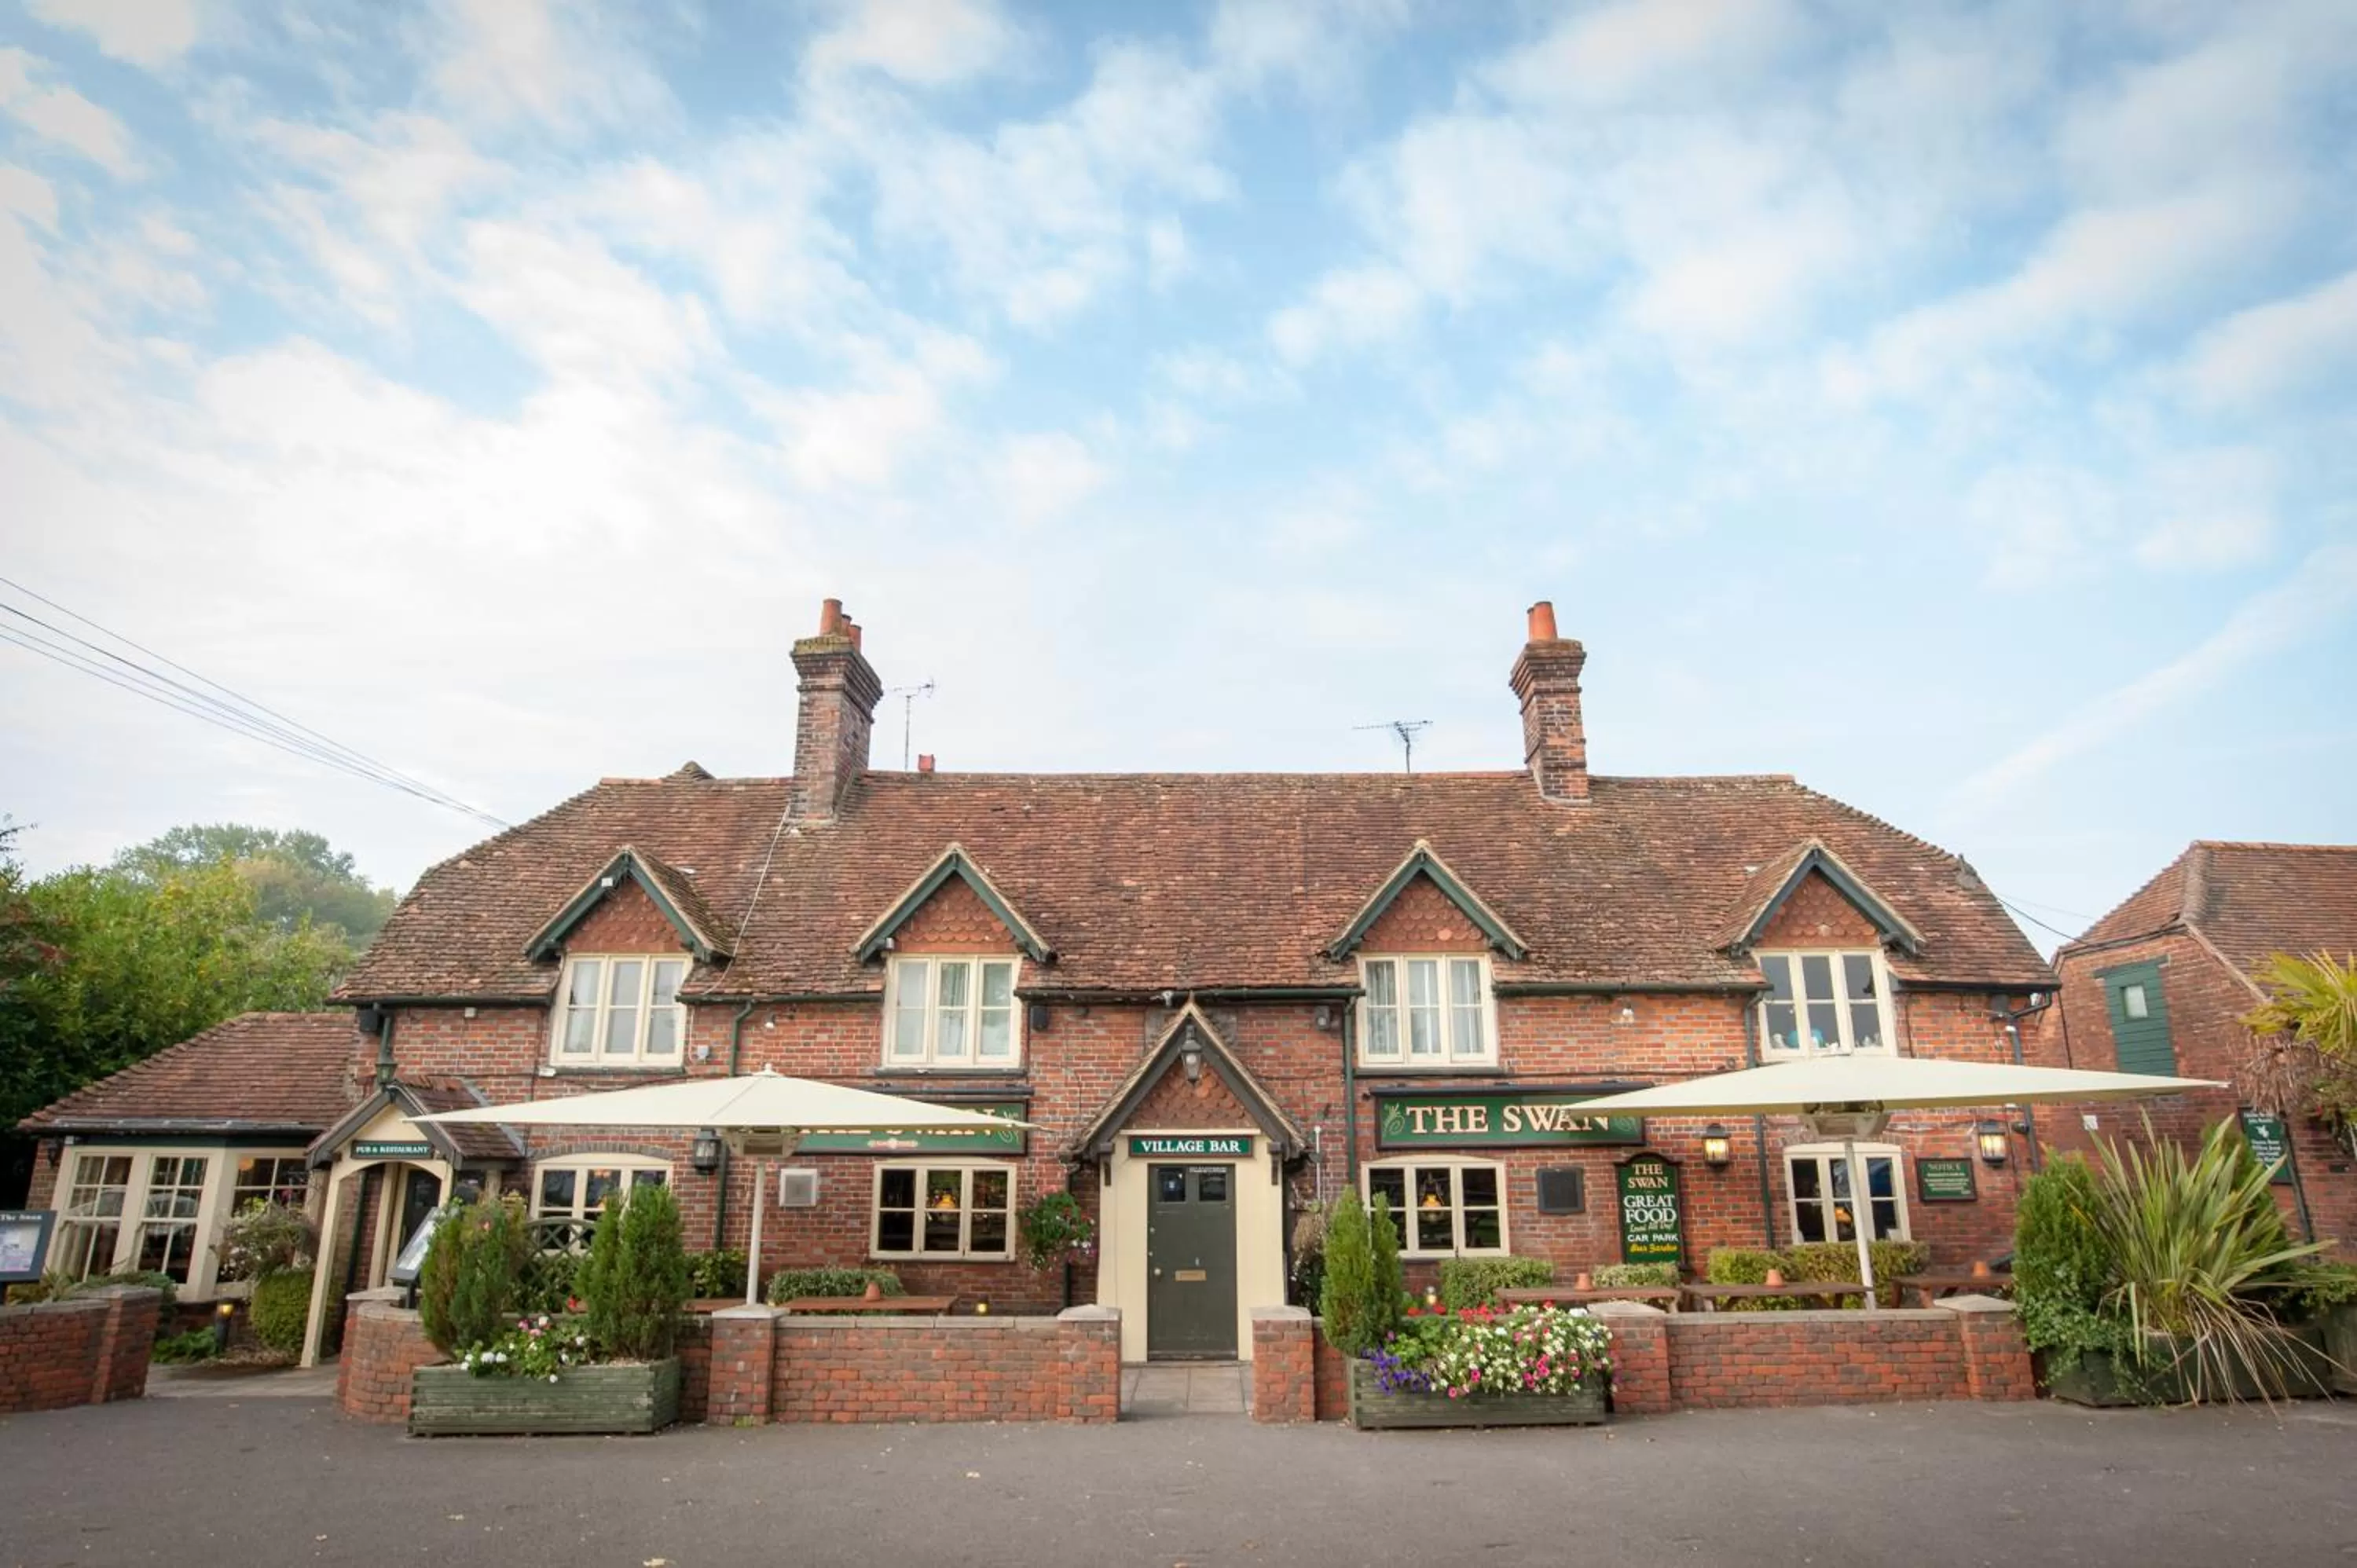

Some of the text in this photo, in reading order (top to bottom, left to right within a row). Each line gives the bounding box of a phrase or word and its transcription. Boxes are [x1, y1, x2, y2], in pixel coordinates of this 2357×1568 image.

[1406, 1105, 1488, 1133] THE
[1142, 1141, 1240, 1152] VILLAGE BAR
[1632, 1163, 1662, 1174] THE
[1627, 1177, 1668, 1189] SWAN
[1623, 1195, 1675, 1207] GREAT
[1625, 1208, 1677, 1223] FOOD
[1652, 1233, 1678, 1242] PARK
